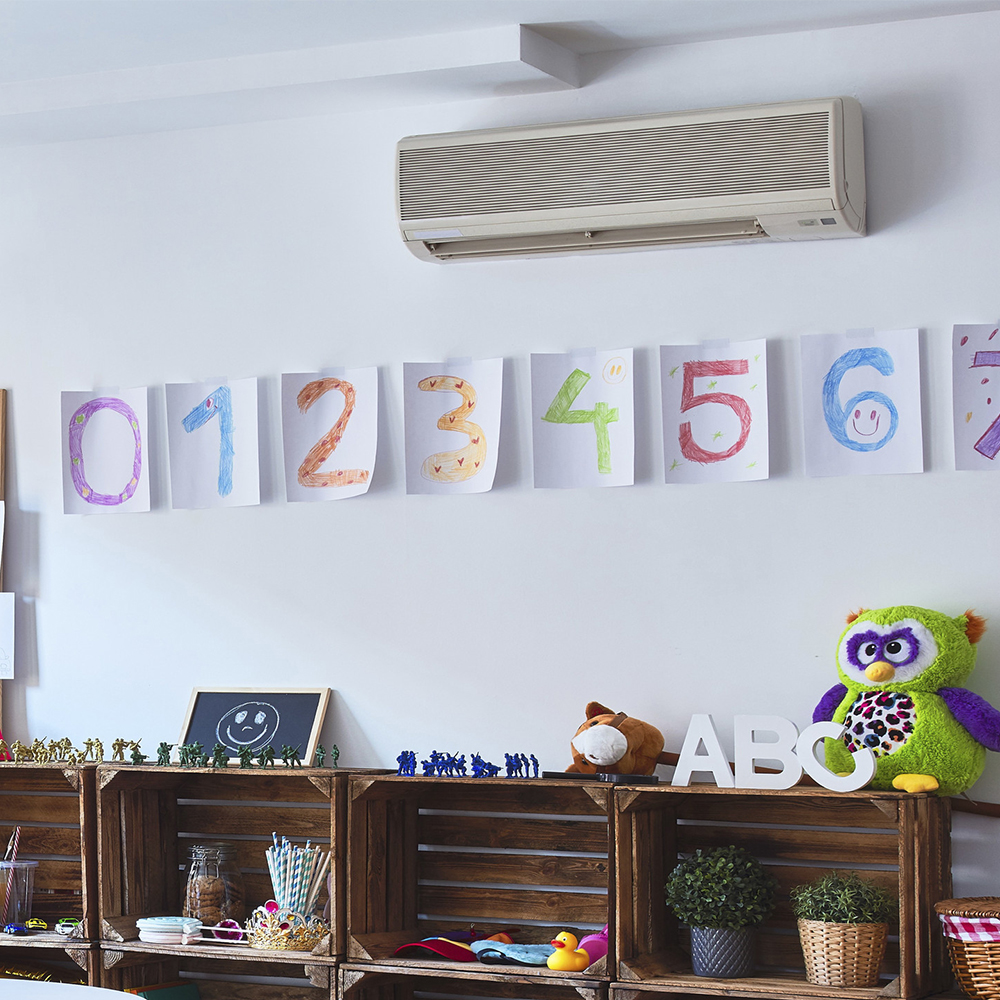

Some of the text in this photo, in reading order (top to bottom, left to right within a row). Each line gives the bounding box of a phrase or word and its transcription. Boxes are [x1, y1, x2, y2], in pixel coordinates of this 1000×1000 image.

[69, 397, 141, 505] 0
[181, 386, 234, 496] 1
[297, 377, 369, 487] 2
[418, 375, 488, 481] 3
[541, 368, 619, 474] 4
[679, 359, 752, 465] 5
[822, 347, 899, 452] 6
[671, 714, 876, 792] ABC
